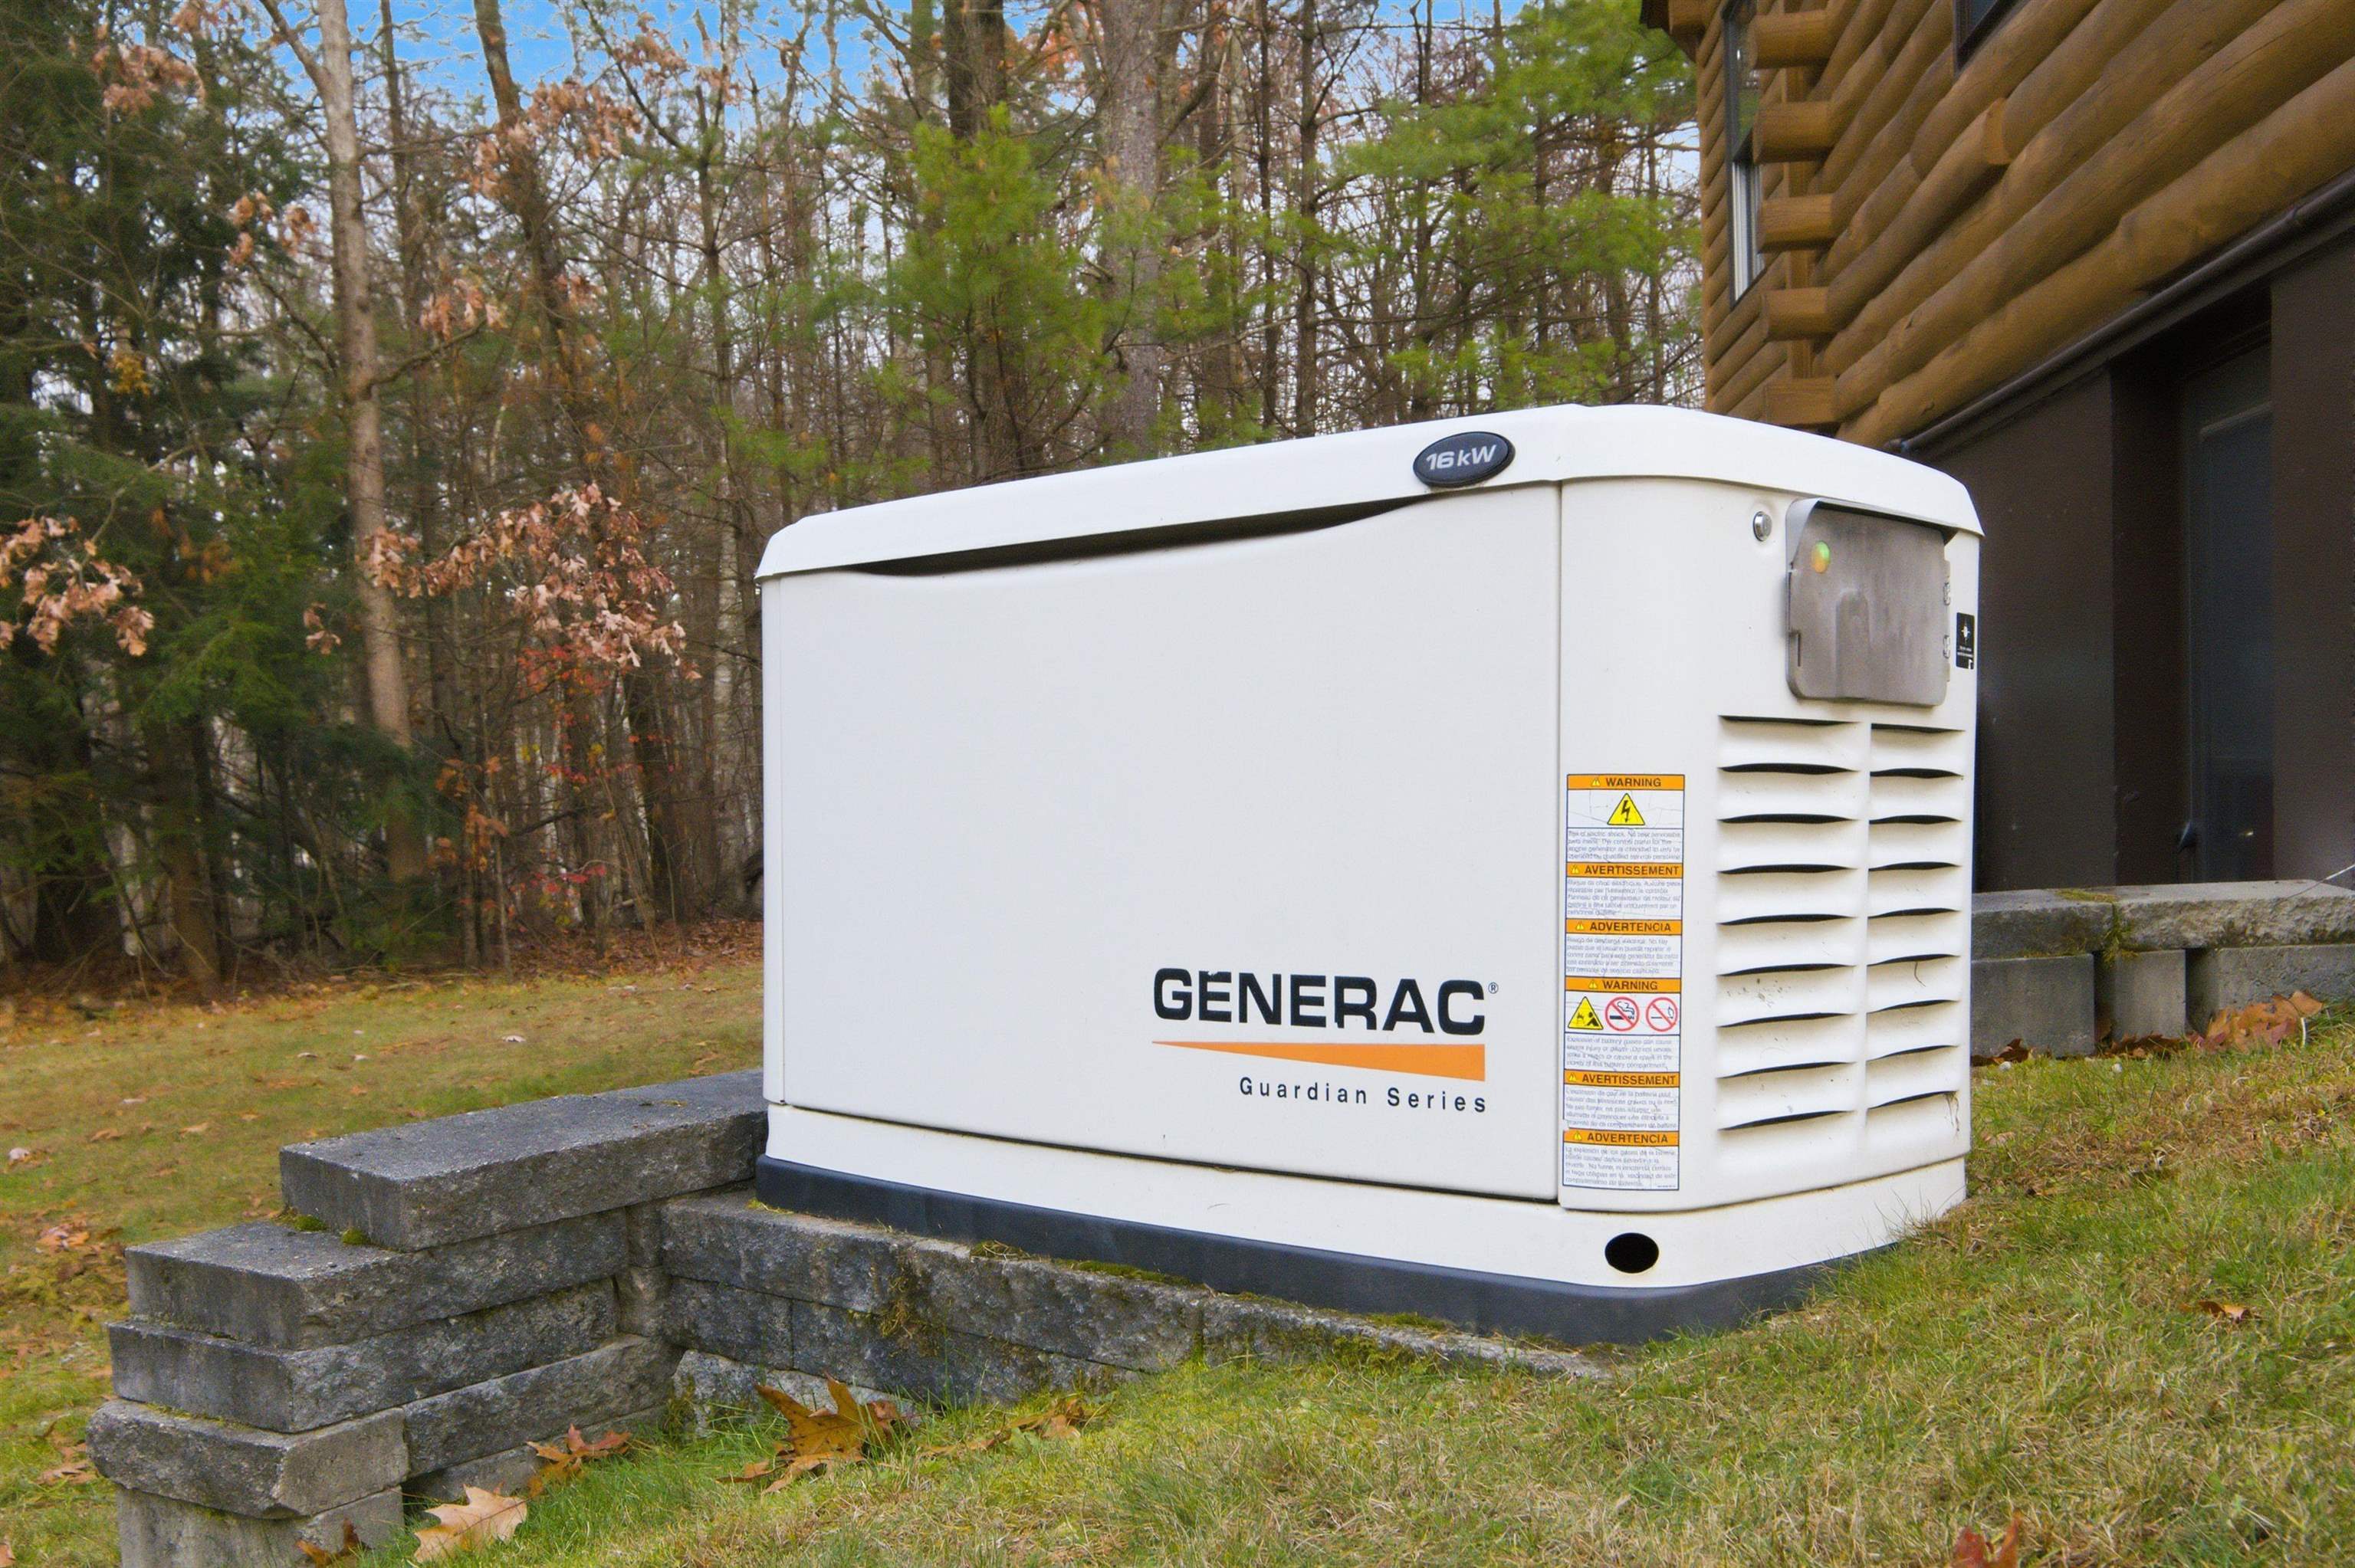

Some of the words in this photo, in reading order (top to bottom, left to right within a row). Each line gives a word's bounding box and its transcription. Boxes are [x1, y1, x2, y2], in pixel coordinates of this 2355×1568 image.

[1605, 777, 1661, 787] WARNING
[1585, 865, 1679, 876] AVERTISSEMENT
[1590, 922, 1671, 932] ADVERTENCIA
[1603, 979, 1658, 991] WARNING
[1581, 1073, 1676, 1085] AVERTISSEMENT
[1240, 1076, 1368, 1105] Guardian
[1387, 1087, 1486, 1113] Series
[1587, 1132, 1668, 1143] ADVERTENCIA
